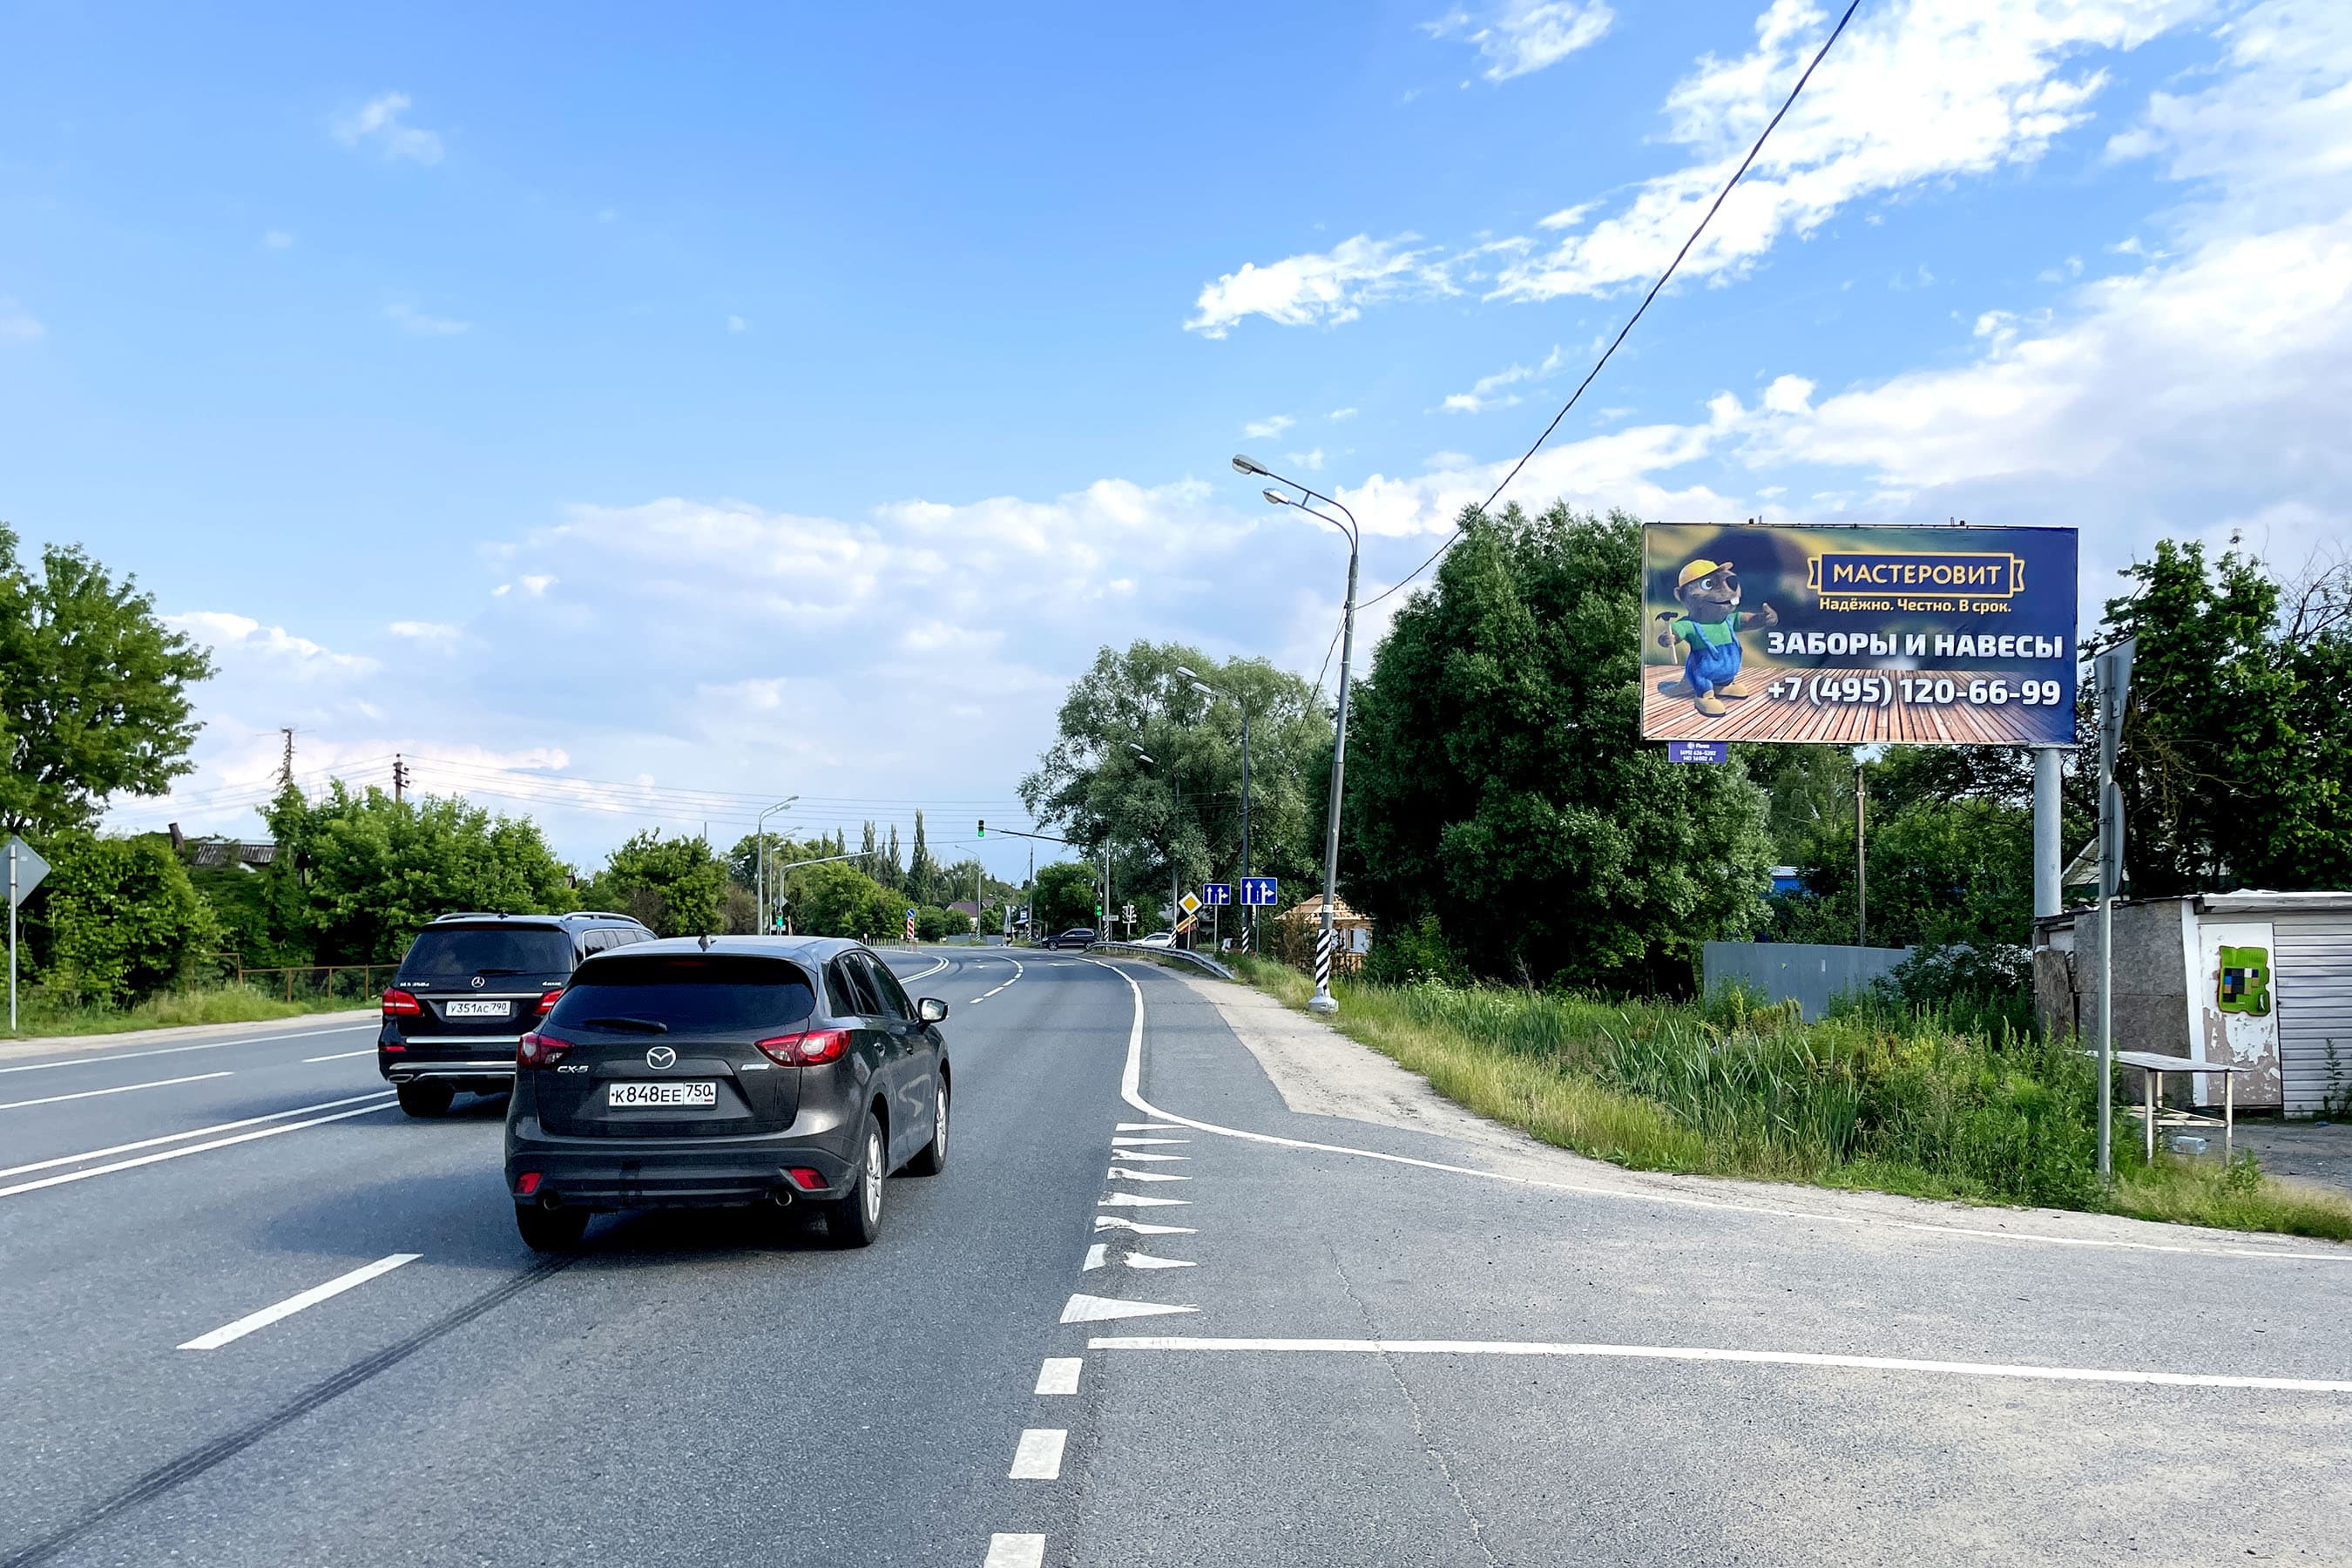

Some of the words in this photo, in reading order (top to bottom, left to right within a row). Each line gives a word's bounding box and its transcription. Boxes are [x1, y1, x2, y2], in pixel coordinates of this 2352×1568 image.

[1833, 564, 2002, 585] МАСТЕРОВИТ
[1819, 597, 1894, 612] Надёжно.
[1897, 598, 1955, 612] Честно.
[1959, 599, 1969, 612] В
[1972, 602, 2012, 615] срок.
[1767, 632, 1897, 655] ЗАБОРЫ
[1905, 633, 1925, 656] И
[1935, 634, 2063, 659] НАВЕСЫ
[1767, 677, 1802, 701] +7
[1809, 675, 1893, 706] (495)
[1900, 679, 2061, 706] 120-66-99
[450, 1003, 489, 1013] У351АС
[614, 1085, 682, 1103] К848ЕЕ
[686, 1085, 711, 1097] 750
